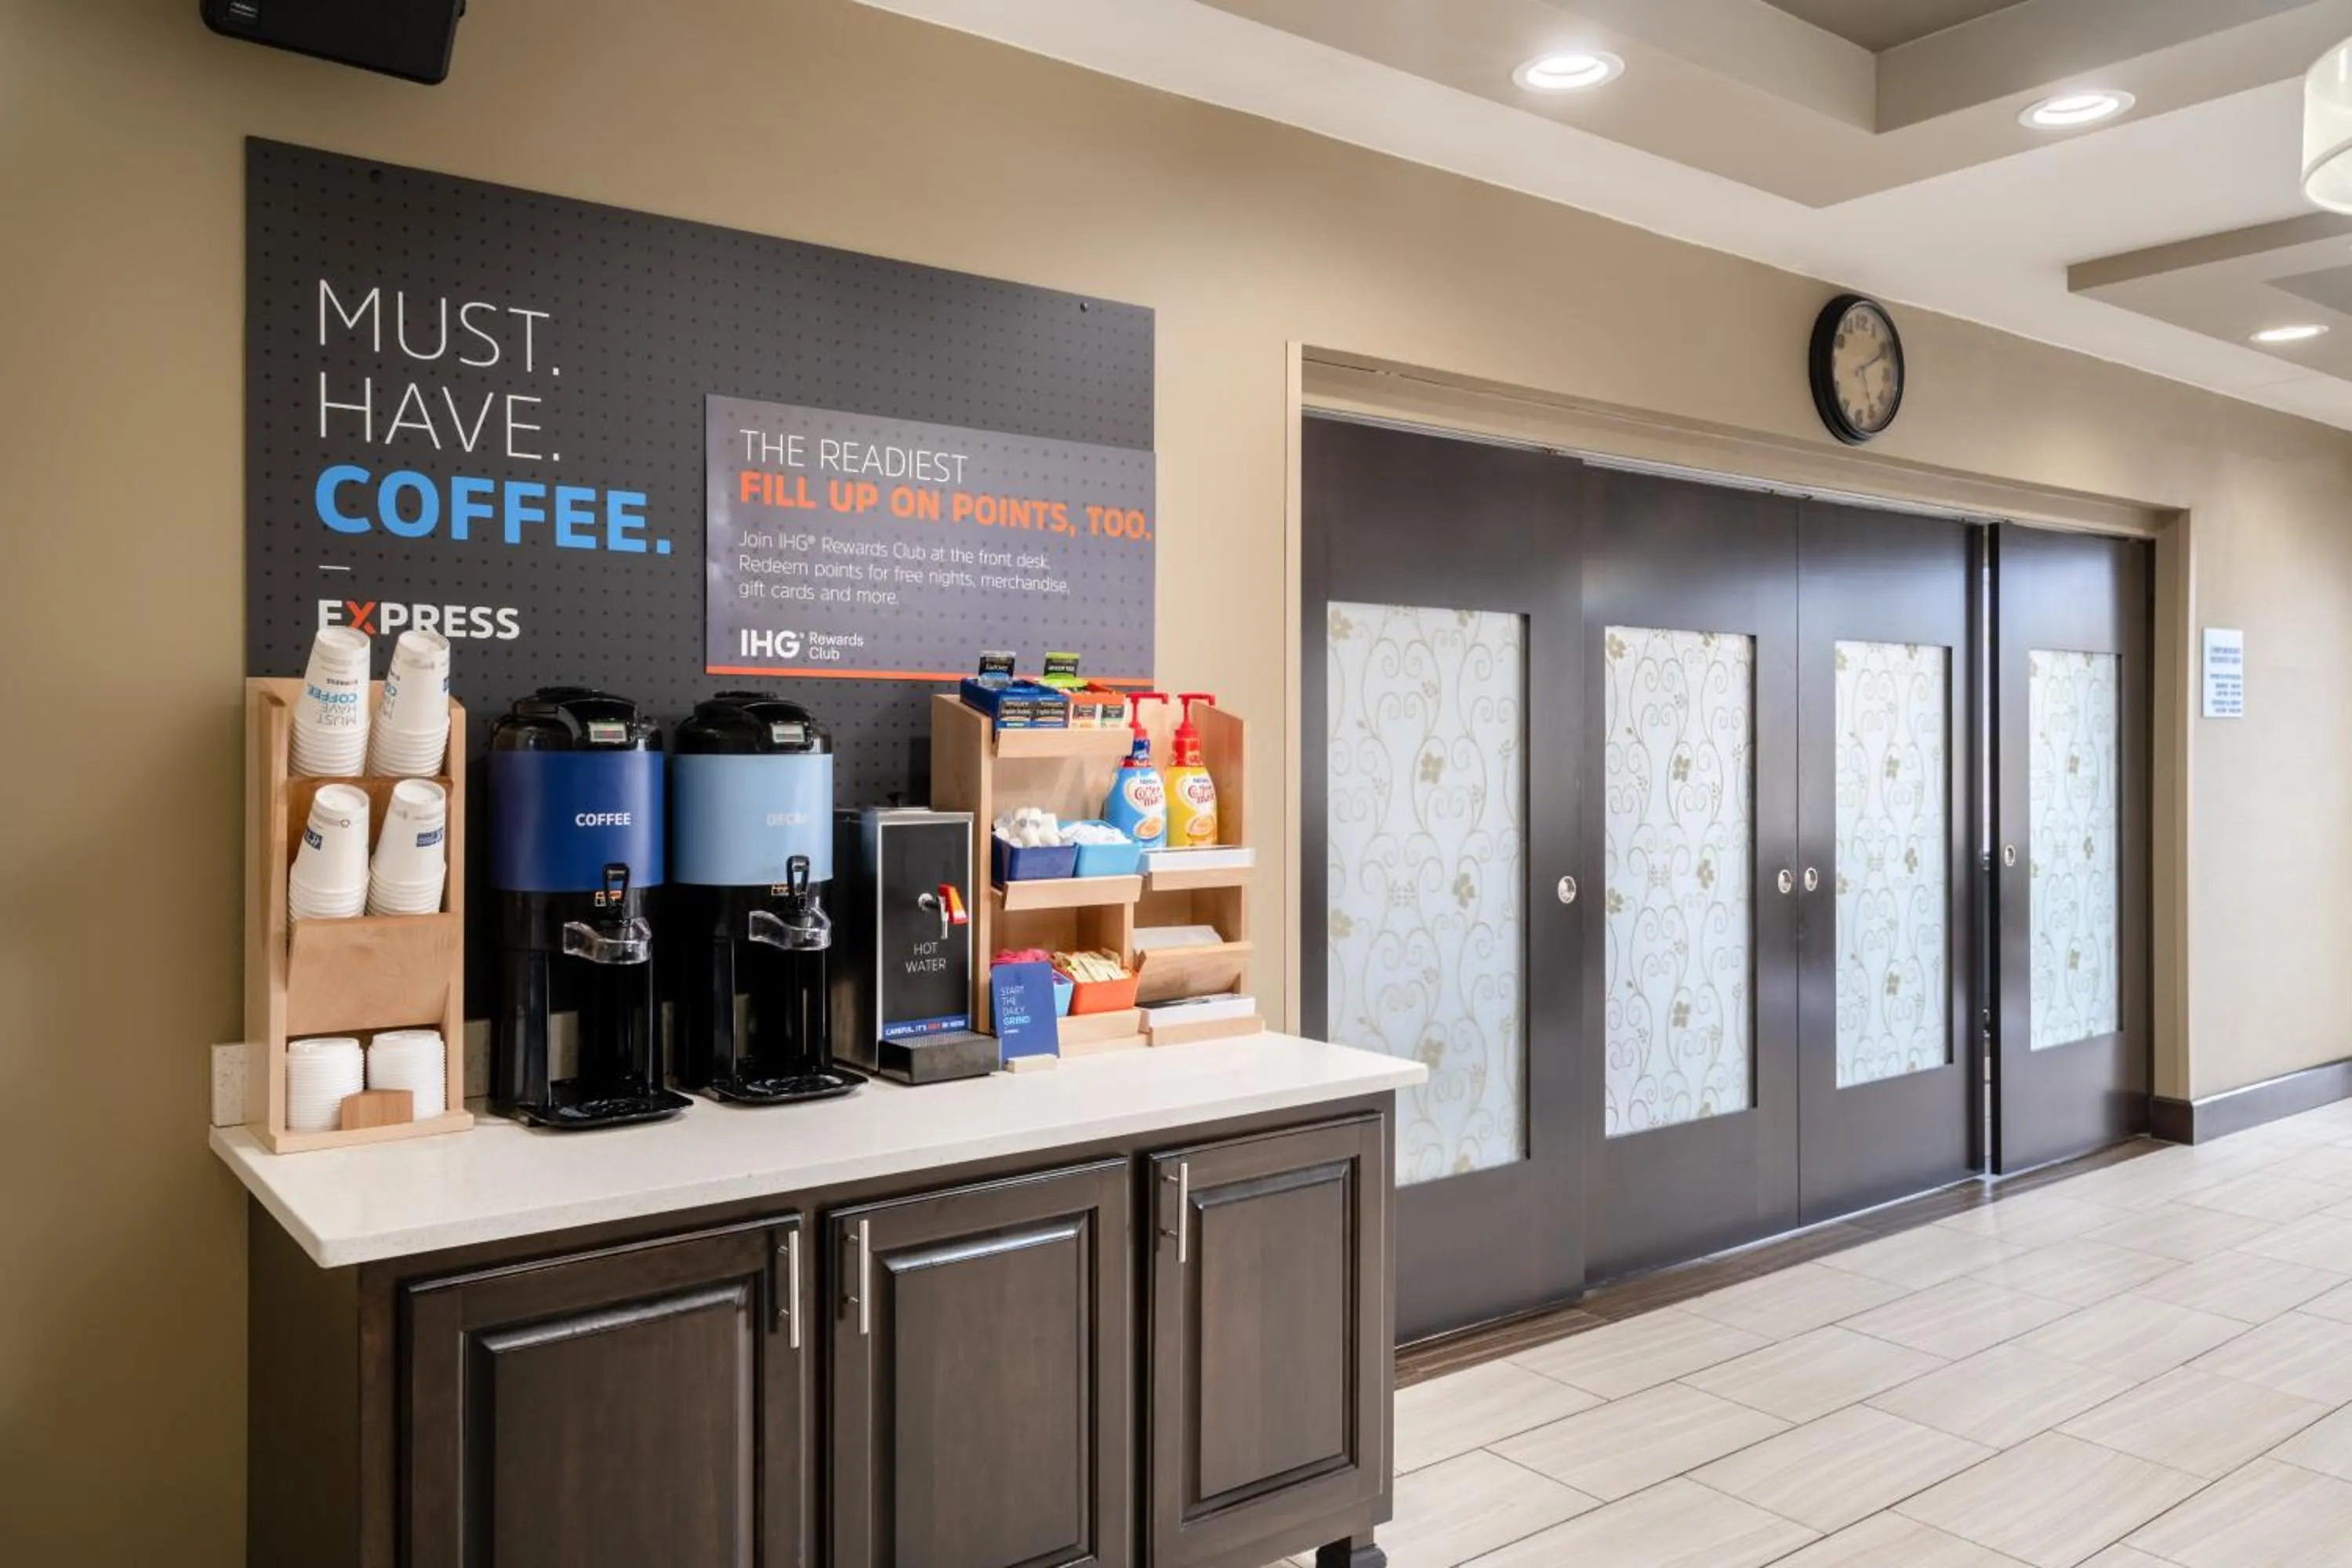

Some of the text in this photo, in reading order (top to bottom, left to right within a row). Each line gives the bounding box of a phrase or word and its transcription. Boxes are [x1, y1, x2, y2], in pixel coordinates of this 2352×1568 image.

[320, 278, 560, 376] MUST.
[320, 371, 560, 461] HAVE.
[740, 429, 968, 485] THE READIEST
[315, 465, 671, 554] COFFEE.
[739, 470, 1152, 541] FILL UP ON POINTS, TOO.
[739, 530, 773, 548] Join
[822, 536, 888, 557] Rewards
[893, 542, 926, 560] Club
[931, 548, 945, 561] at
[950, 547, 975, 564] the
[978, 550, 1012, 567] front
[1017, 553, 1051, 570] desk.
[739, 554, 1070, 595] Redeem points for free nights, merchandise,
[739, 580, 899, 605] gift cards and more.
[318, 599, 521, 640] EXPRESS
[808, 631, 864, 647] Rewards
[808, 646, 840, 660] Club
[575, 812, 632, 827] COFFEE
[905, 957, 946, 974] WATER
[913, 942, 938, 956] HOT
